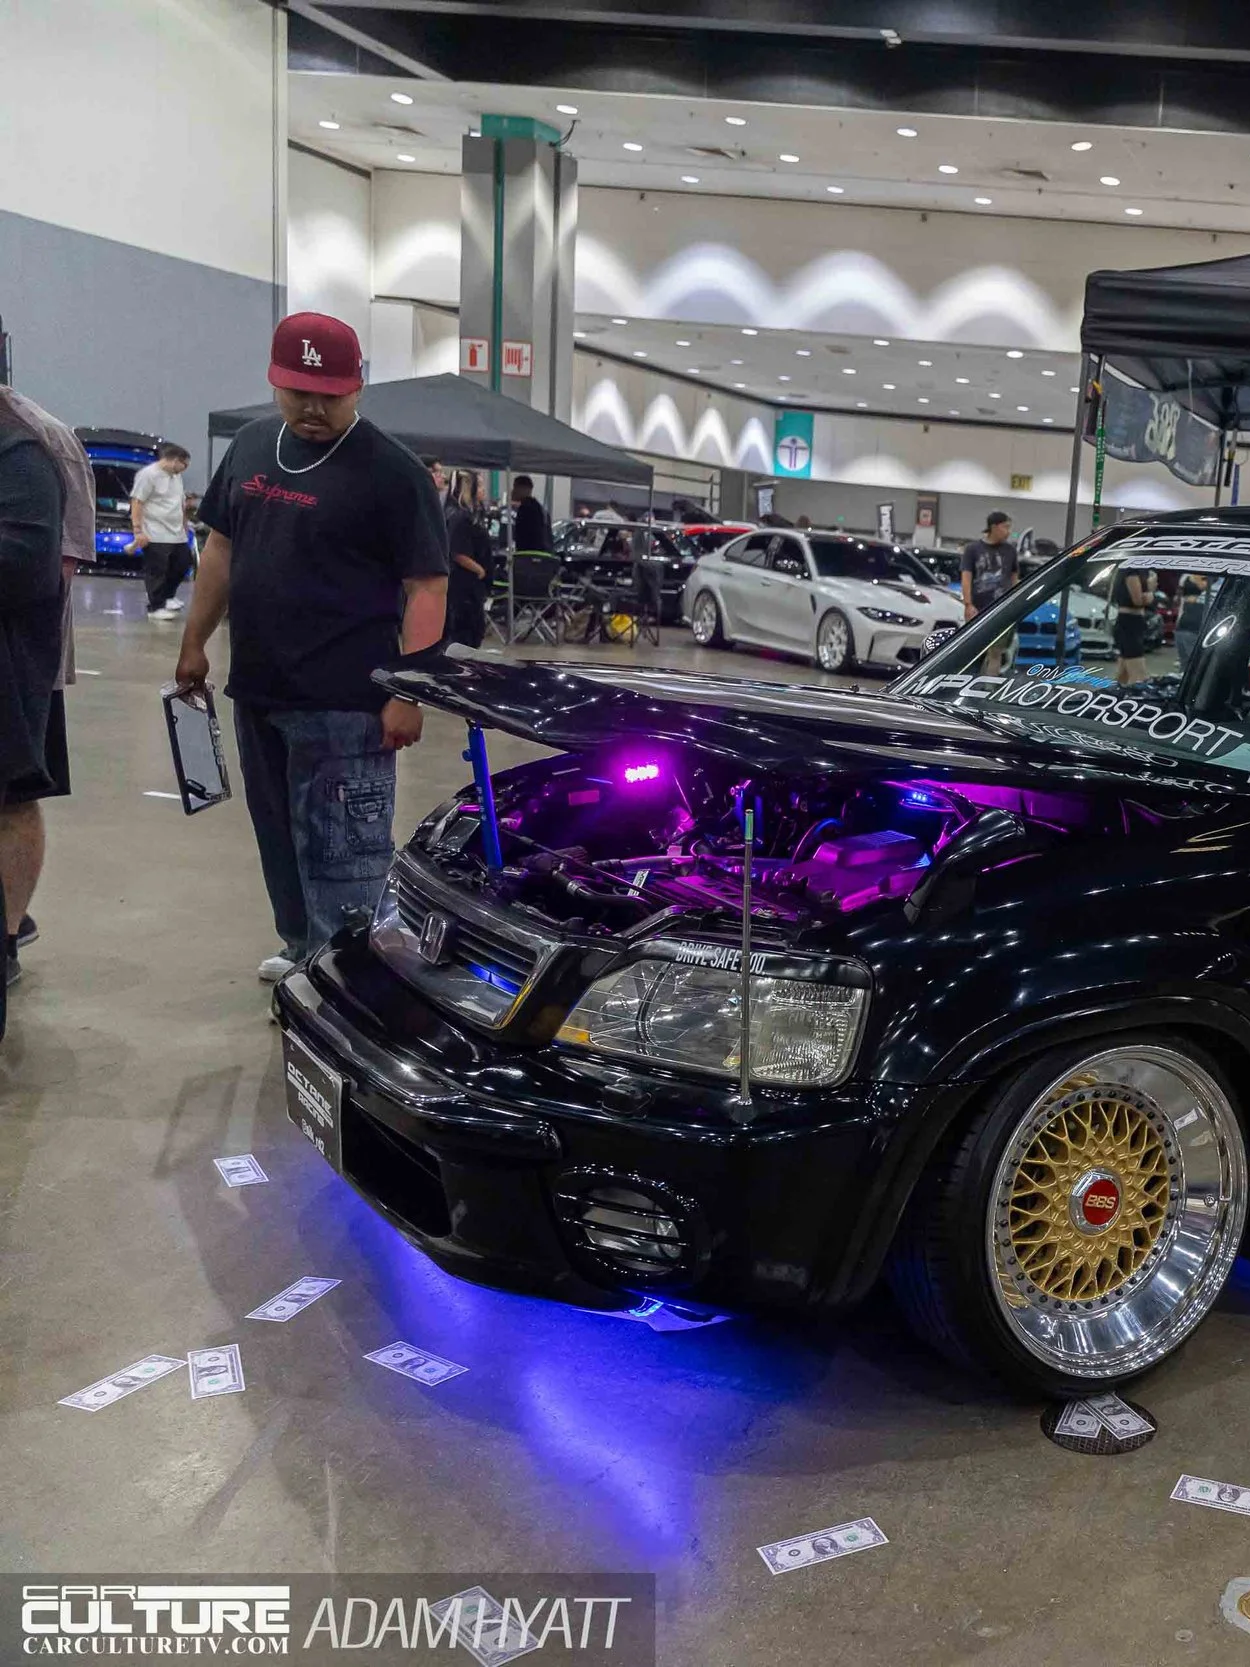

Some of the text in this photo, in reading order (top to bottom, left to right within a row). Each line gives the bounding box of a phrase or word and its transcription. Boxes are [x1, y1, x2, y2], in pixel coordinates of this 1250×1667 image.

[302, 339, 322, 367] LA
[989, 678, 1244, 756] MOTORSPORT
[675, 941, 712, 966] DRIVE
[710, 946, 743, 970] SAFE
[287, 1061, 332, 1117] OCTANE
[1085, 1194, 1116, 1209] BBS
